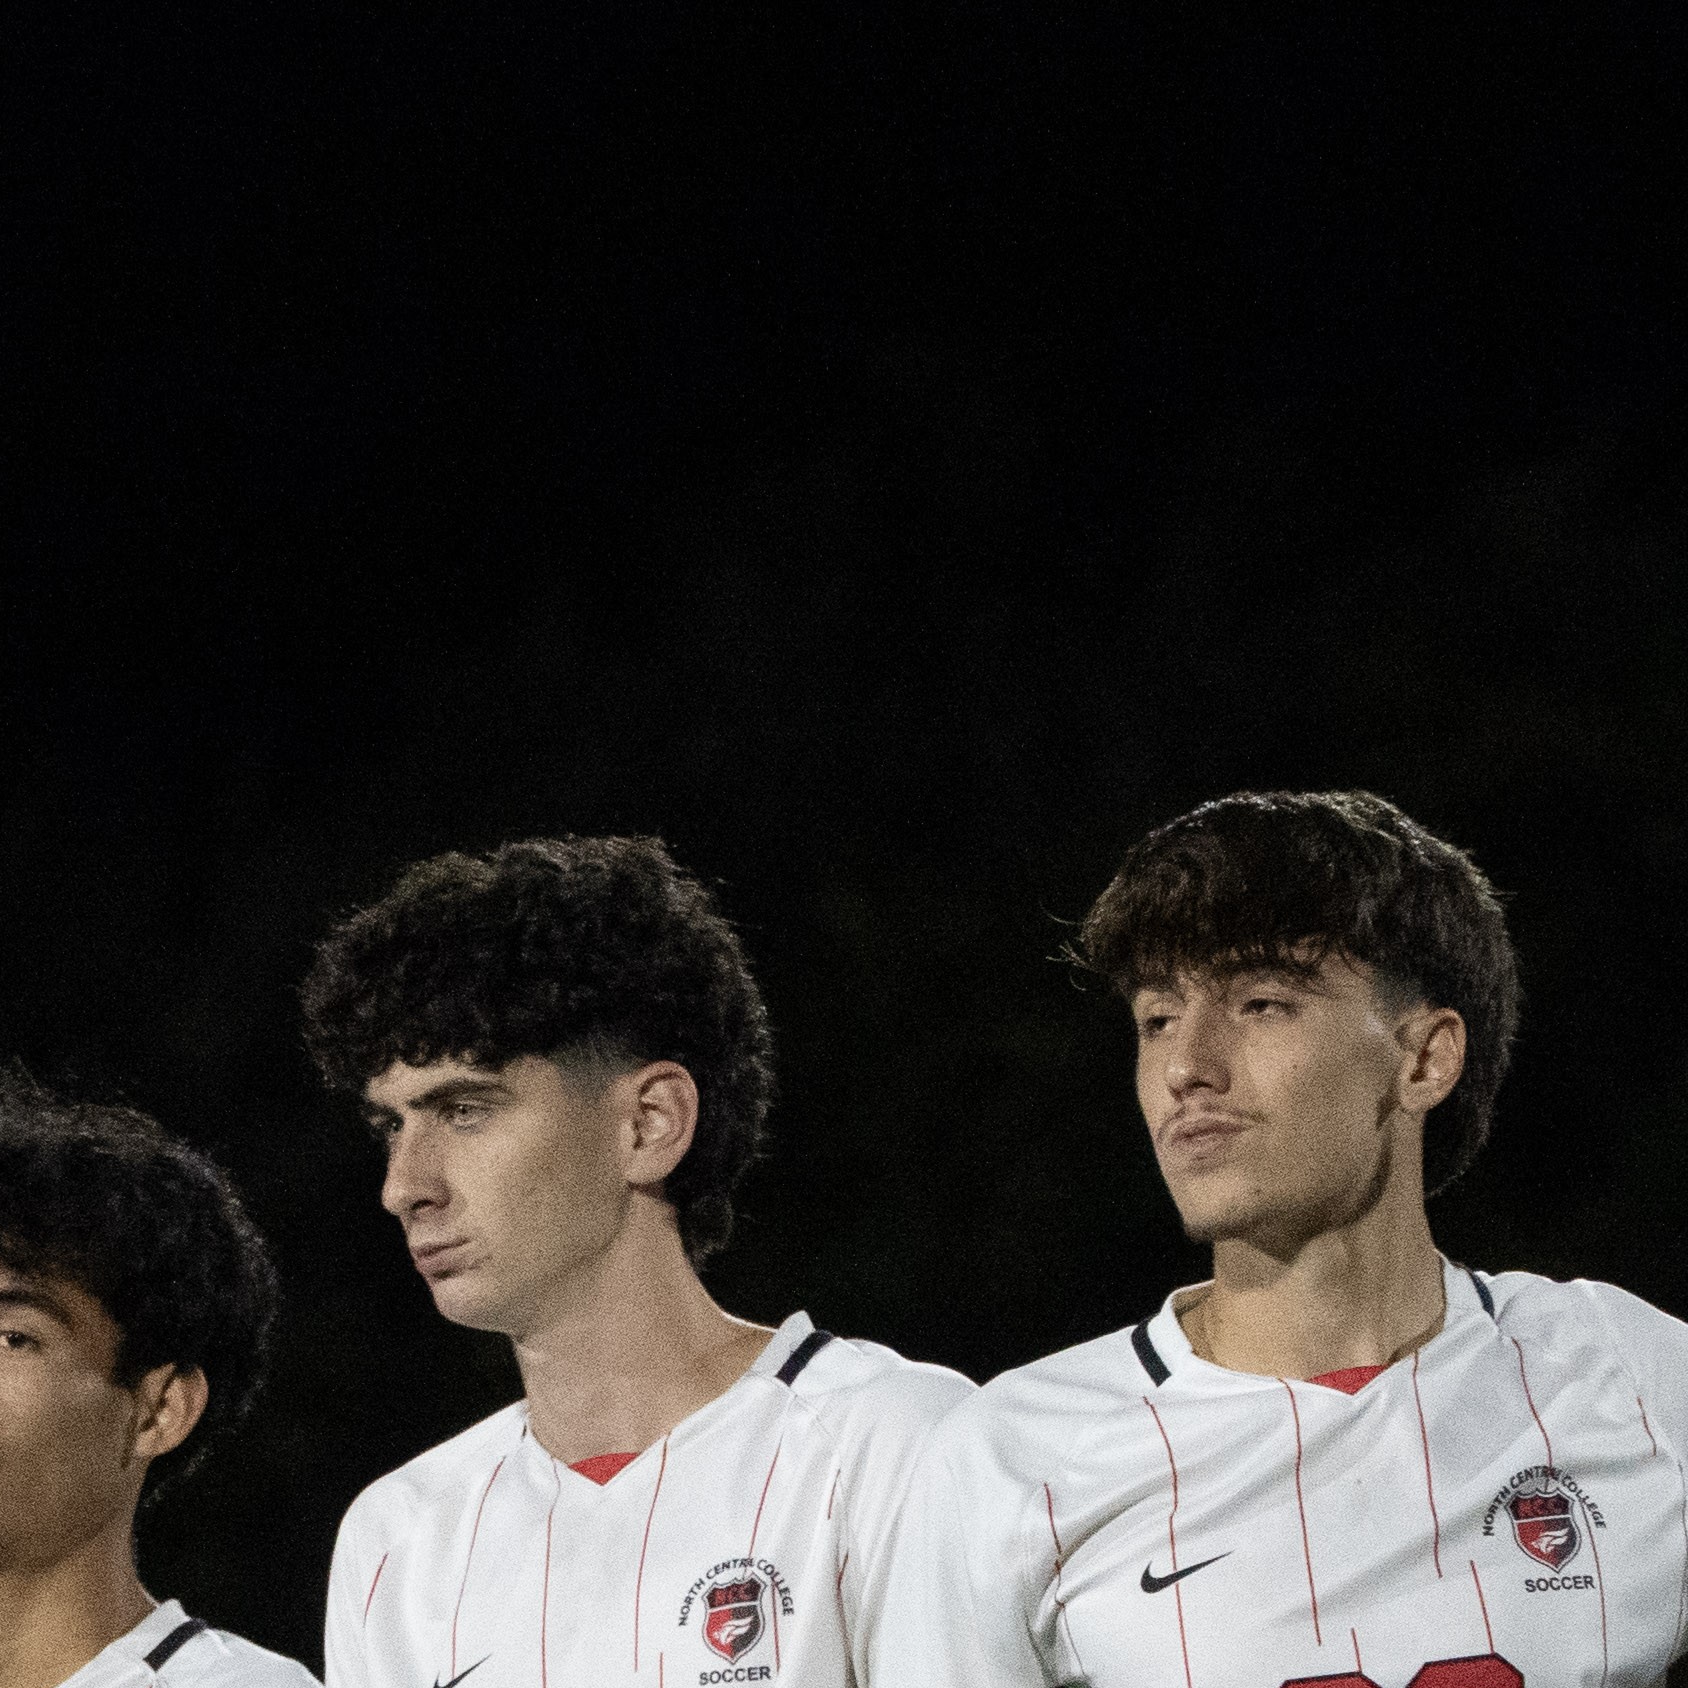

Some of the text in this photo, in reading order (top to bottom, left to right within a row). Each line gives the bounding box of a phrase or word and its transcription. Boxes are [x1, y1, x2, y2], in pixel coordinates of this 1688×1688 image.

[1482, 1486, 1511, 1536] NORTH
[678, 1578, 706, 1626] NORTH
[757, 1559, 794, 1616] COLLEGE
[1525, 1575, 1595, 1593] SOCCER
[699, 1666, 771, 1686] SOCCER
